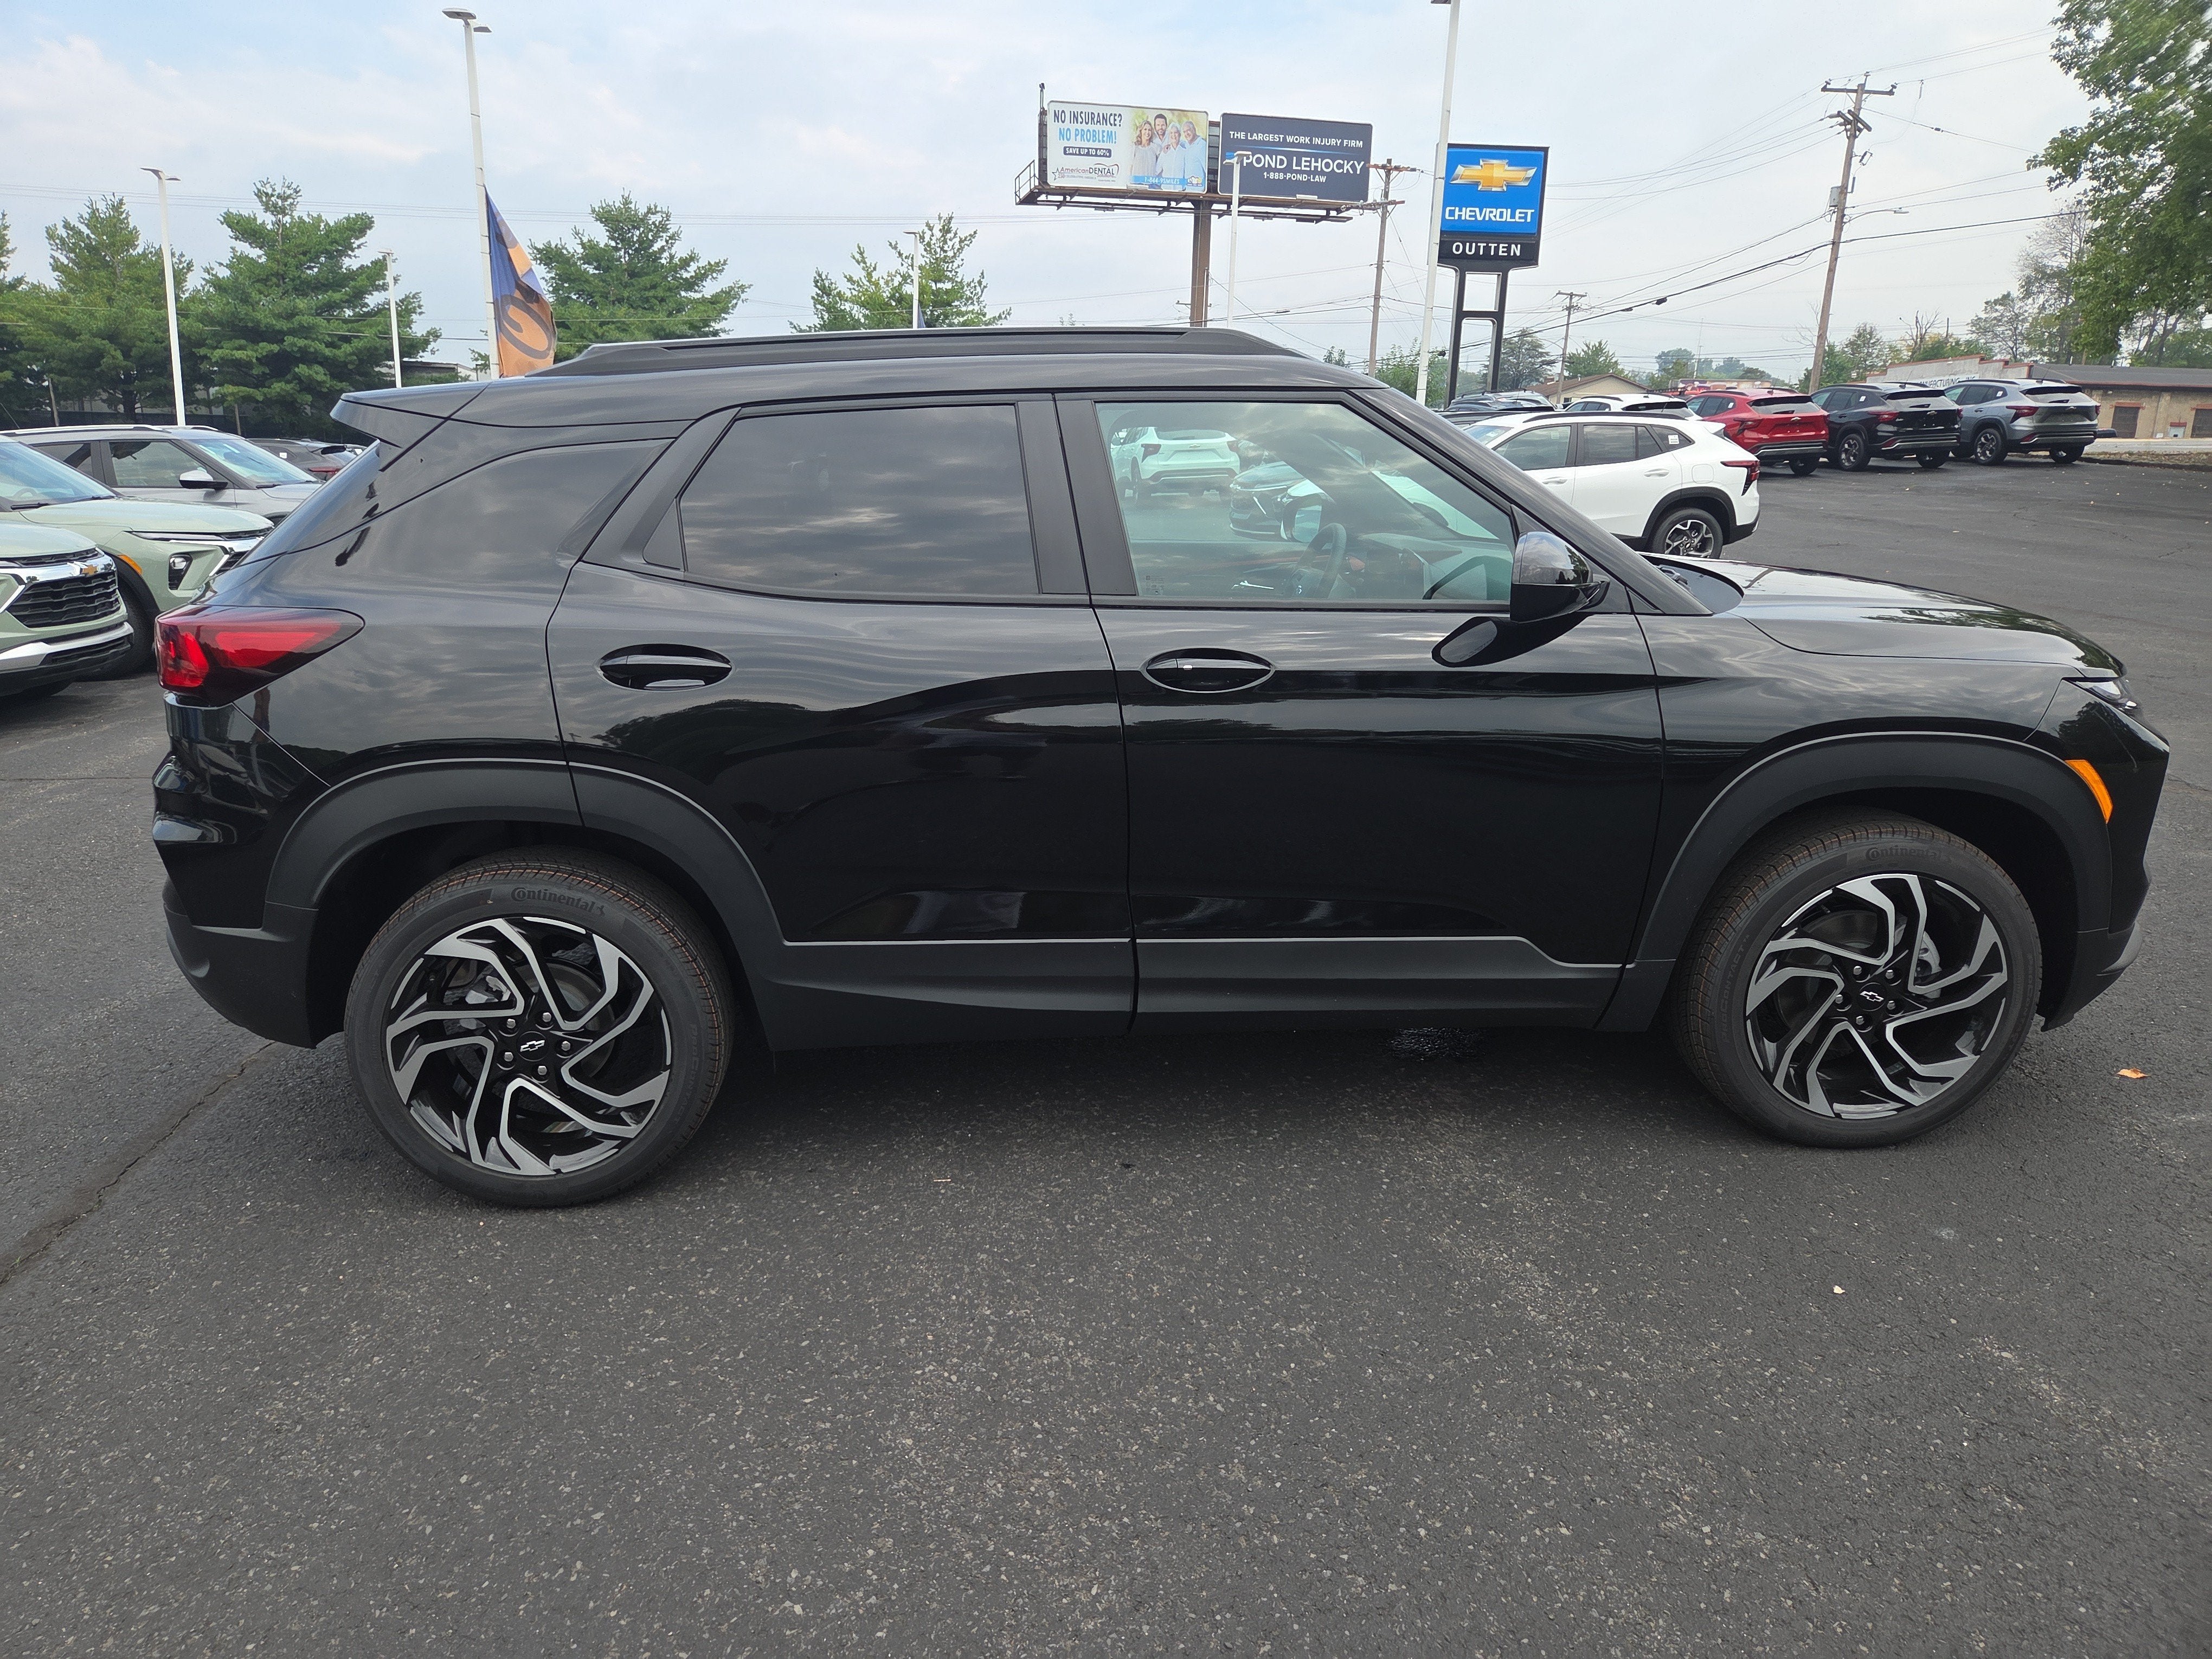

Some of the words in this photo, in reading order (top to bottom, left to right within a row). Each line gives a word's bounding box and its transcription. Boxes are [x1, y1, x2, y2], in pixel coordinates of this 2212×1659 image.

[1053, 110, 1066, 124] NO
[1070, 111, 1122, 127] INSURANCE?
[1059, 127, 1071, 142] NO
[1075, 128, 1117, 144] PROBLEM!
[1230, 131, 1245, 140] THE
[1248, 133, 1284, 142] LARGEST
[1286, 135, 1310, 144] WORK
[1312, 137, 1342, 146] INJURY
[1343, 139, 1363, 148] FIRM
[1243, 153, 1287, 169] POND
[1293, 156, 1365, 175] LEHOCKY
[1445, 207, 1535, 222] CHEVROLET
[1452, 242, 1521, 256] OUTTEN
[1866, 845, 1941, 861] Continental
[511, 887, 595, 913] Continental
